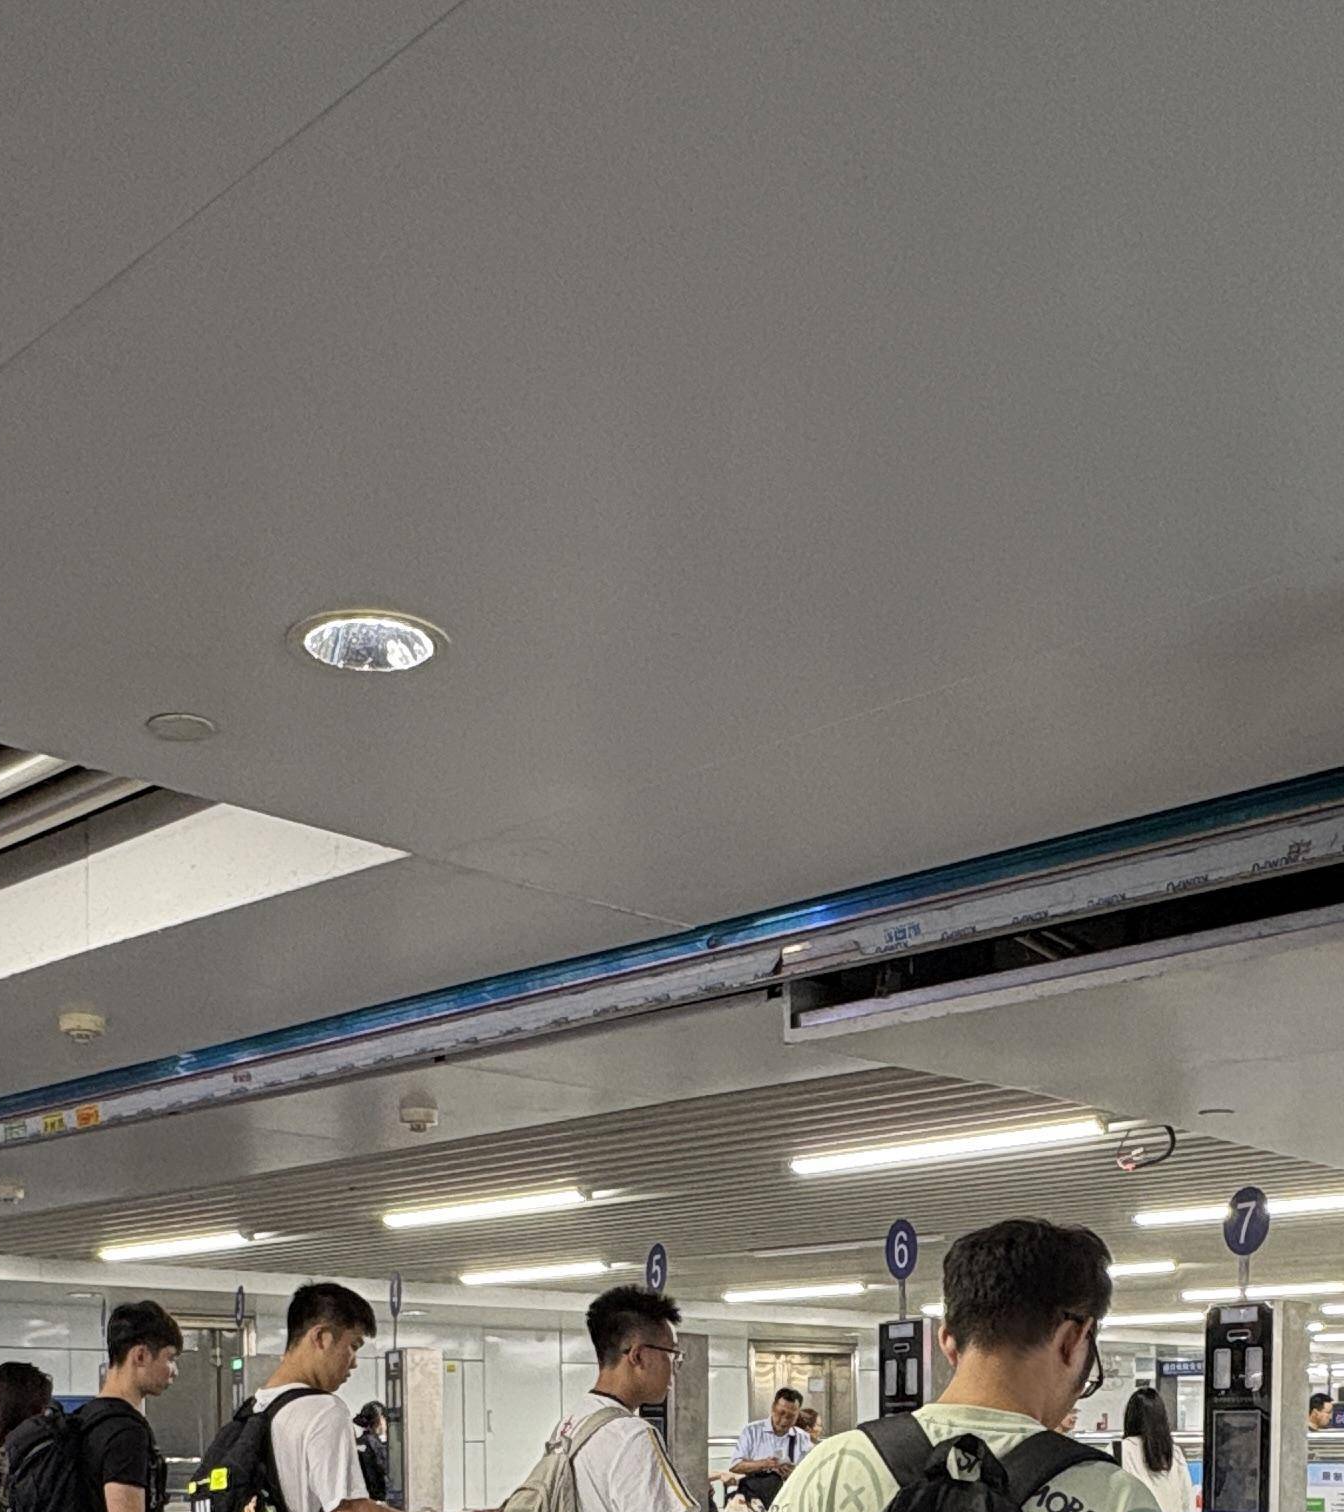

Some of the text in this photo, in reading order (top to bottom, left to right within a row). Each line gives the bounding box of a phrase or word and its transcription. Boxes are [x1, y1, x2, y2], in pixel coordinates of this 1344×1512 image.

[1237, 1203, 1255, 1244] 7
[893, 1232, 909, 1268] 6
[652, 1255, 661, 1289] 5
